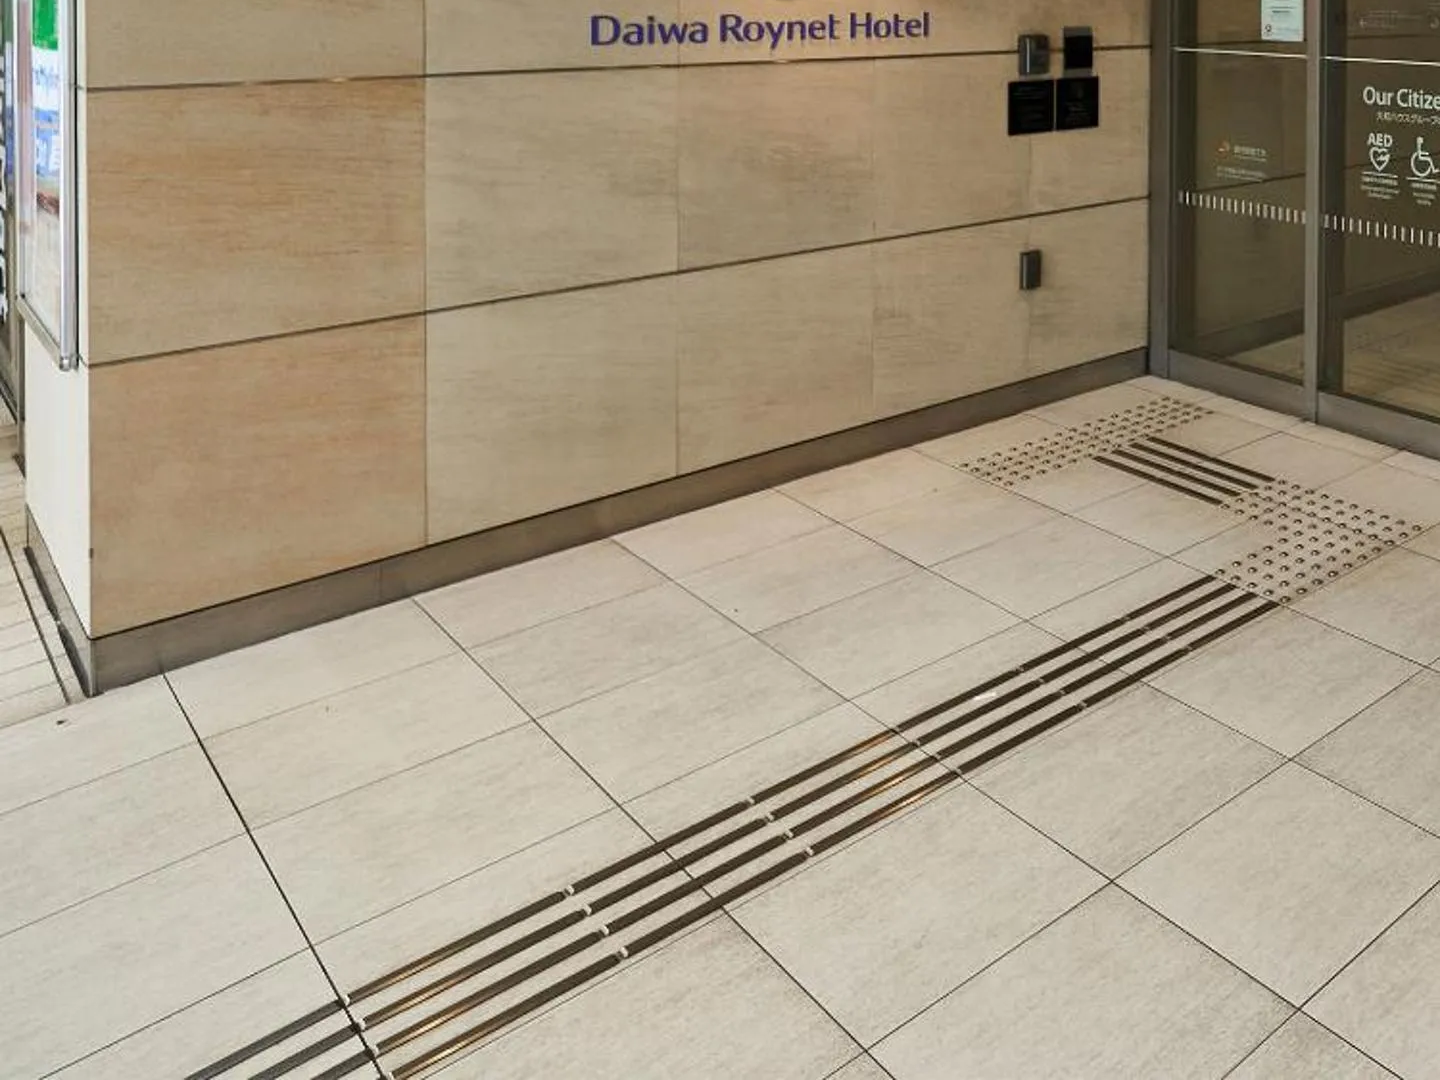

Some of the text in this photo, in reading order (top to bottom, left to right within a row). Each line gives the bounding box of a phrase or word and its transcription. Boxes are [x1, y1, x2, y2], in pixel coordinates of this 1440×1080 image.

[590, 11, 931, 50] Daiwa Roynet Hotel
[1362, 86, 1394, 106] Our
[1367, 132, 1394, 147] AED
